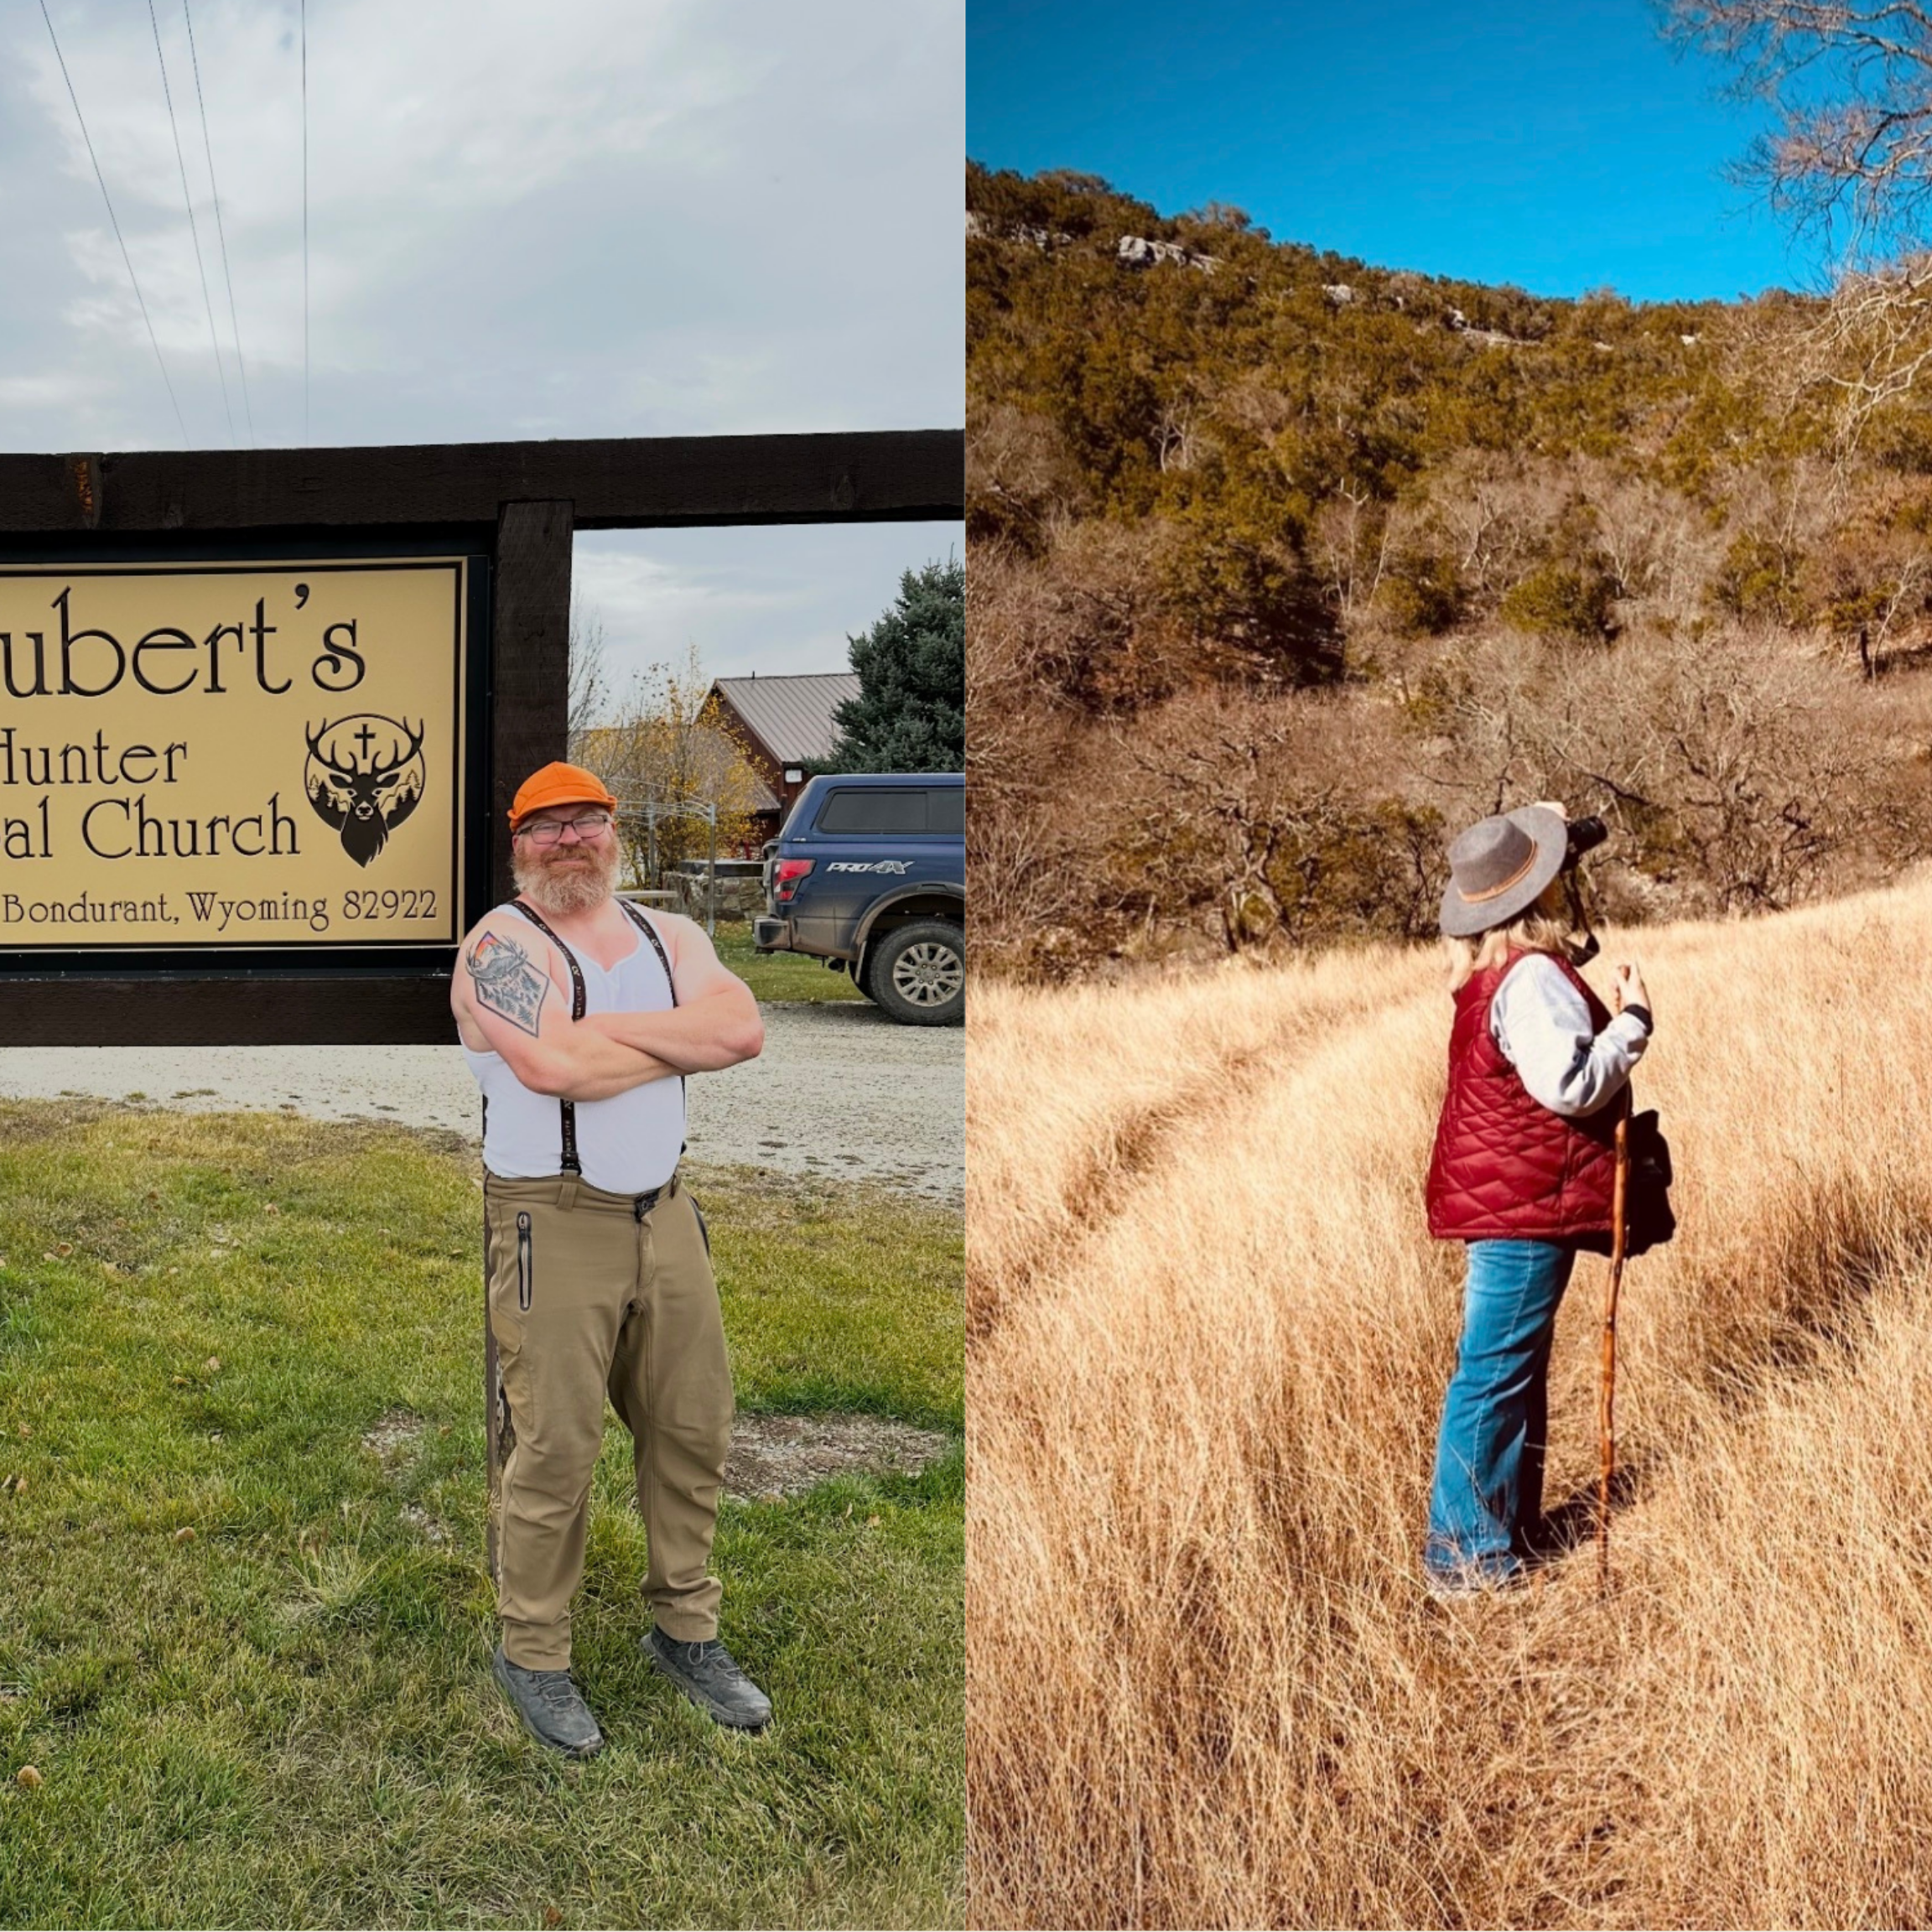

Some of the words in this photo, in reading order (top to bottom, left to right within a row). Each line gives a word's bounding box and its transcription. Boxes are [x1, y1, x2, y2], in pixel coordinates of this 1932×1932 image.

[82, 792, 302, 860] Church
[3, 891, 179, 925] Bondurant,
[186, 891, 330, 932] Wyoming
[343, 890, 438, 921] 82922
